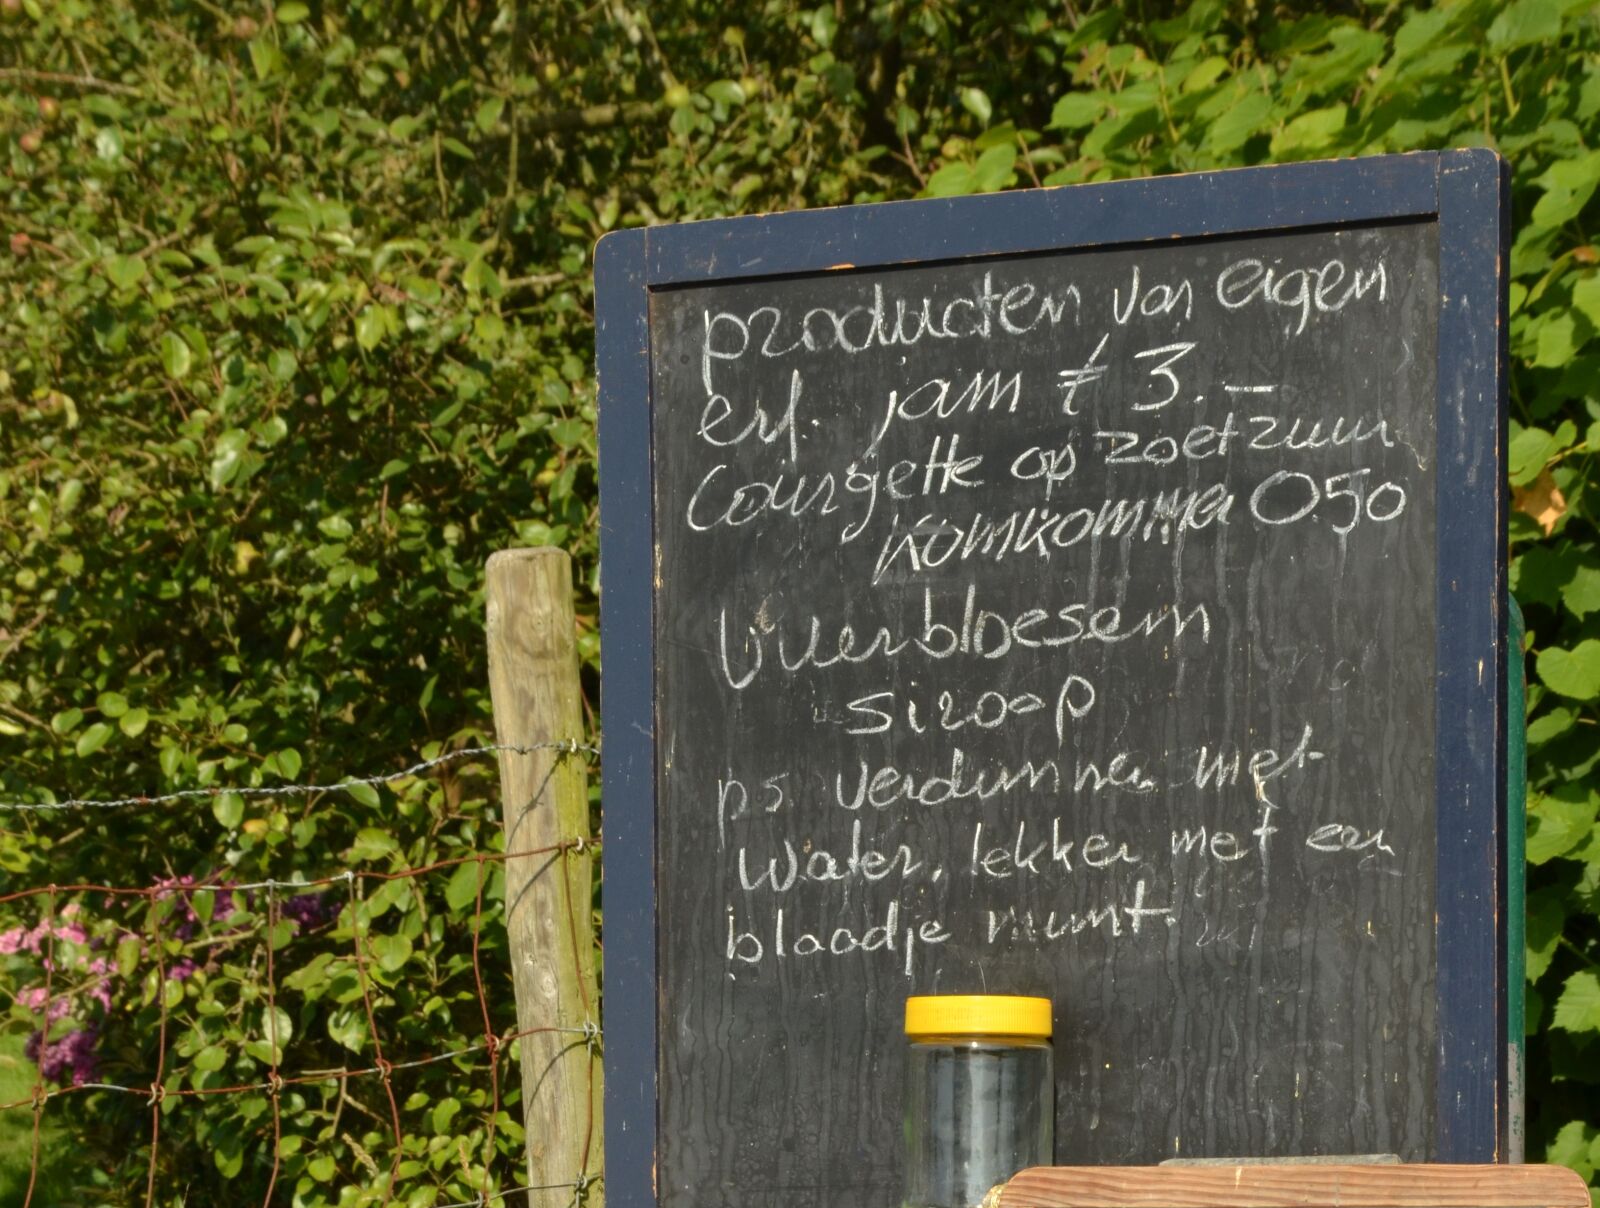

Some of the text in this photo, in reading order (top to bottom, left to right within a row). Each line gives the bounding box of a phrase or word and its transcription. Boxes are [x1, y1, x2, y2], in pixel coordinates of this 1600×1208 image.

[702, 271, 1081, 396] producten
[1216, 256, 1388, 337] eigen
[1171, 806, 1279, 862] met
